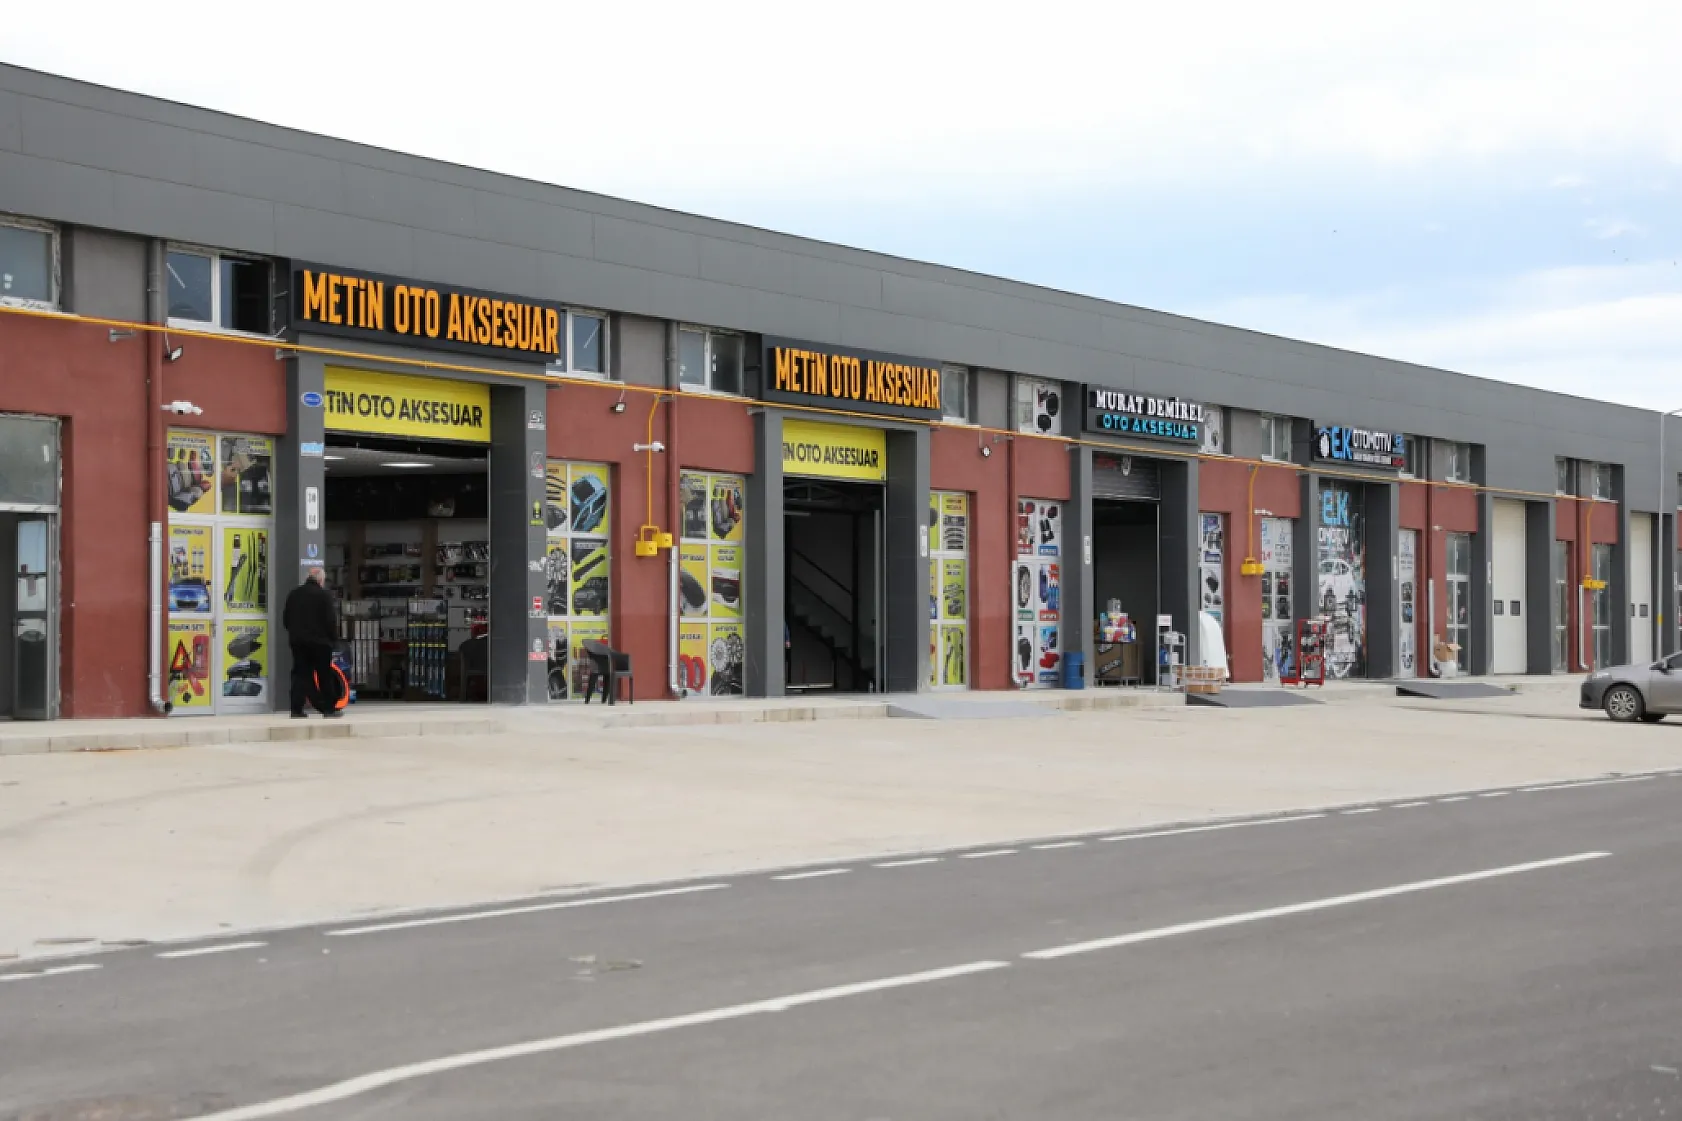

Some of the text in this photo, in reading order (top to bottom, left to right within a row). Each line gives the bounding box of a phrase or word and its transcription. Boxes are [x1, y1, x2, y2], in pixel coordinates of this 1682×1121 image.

[393, 284, 440, 338] OTO
[447, 293, 560, 354] AKSESUAR
[831, 353, 861, 400] OTO
[866, 360, 941, 410] AKSESUAR
[324, 390, 483, 428] TİN OTO AKSESUAR
[1096, 389, 1204, 422] MURAT DEMİREL
[1103, 413, 1198, 439] OTO AKSESUAR
[797, 443, 821, 463] OTO
[823, 446, 879, 468] AKSESUAR
